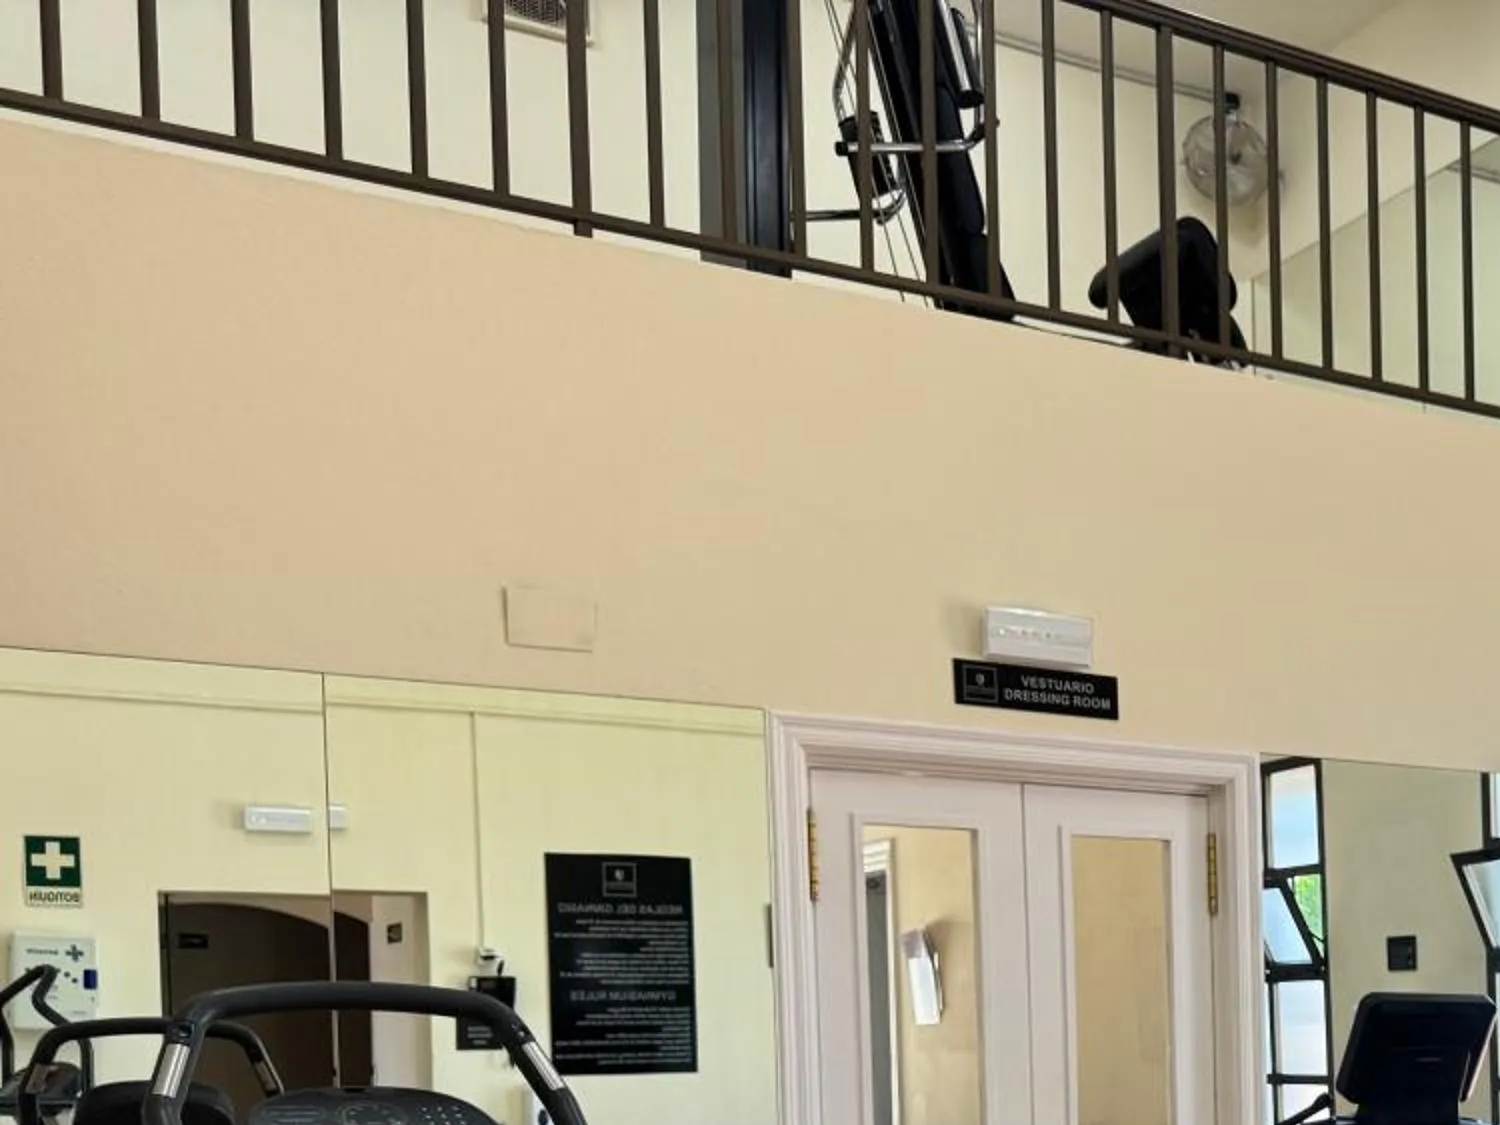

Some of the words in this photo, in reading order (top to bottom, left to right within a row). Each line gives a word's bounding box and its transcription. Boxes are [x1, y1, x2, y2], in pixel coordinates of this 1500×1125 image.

[1020, 674, 1095, 694] VESTUARIO
[1004, 688, 1070, 706] DRESSING
[1073, 694, 1112, 711] ROOM
